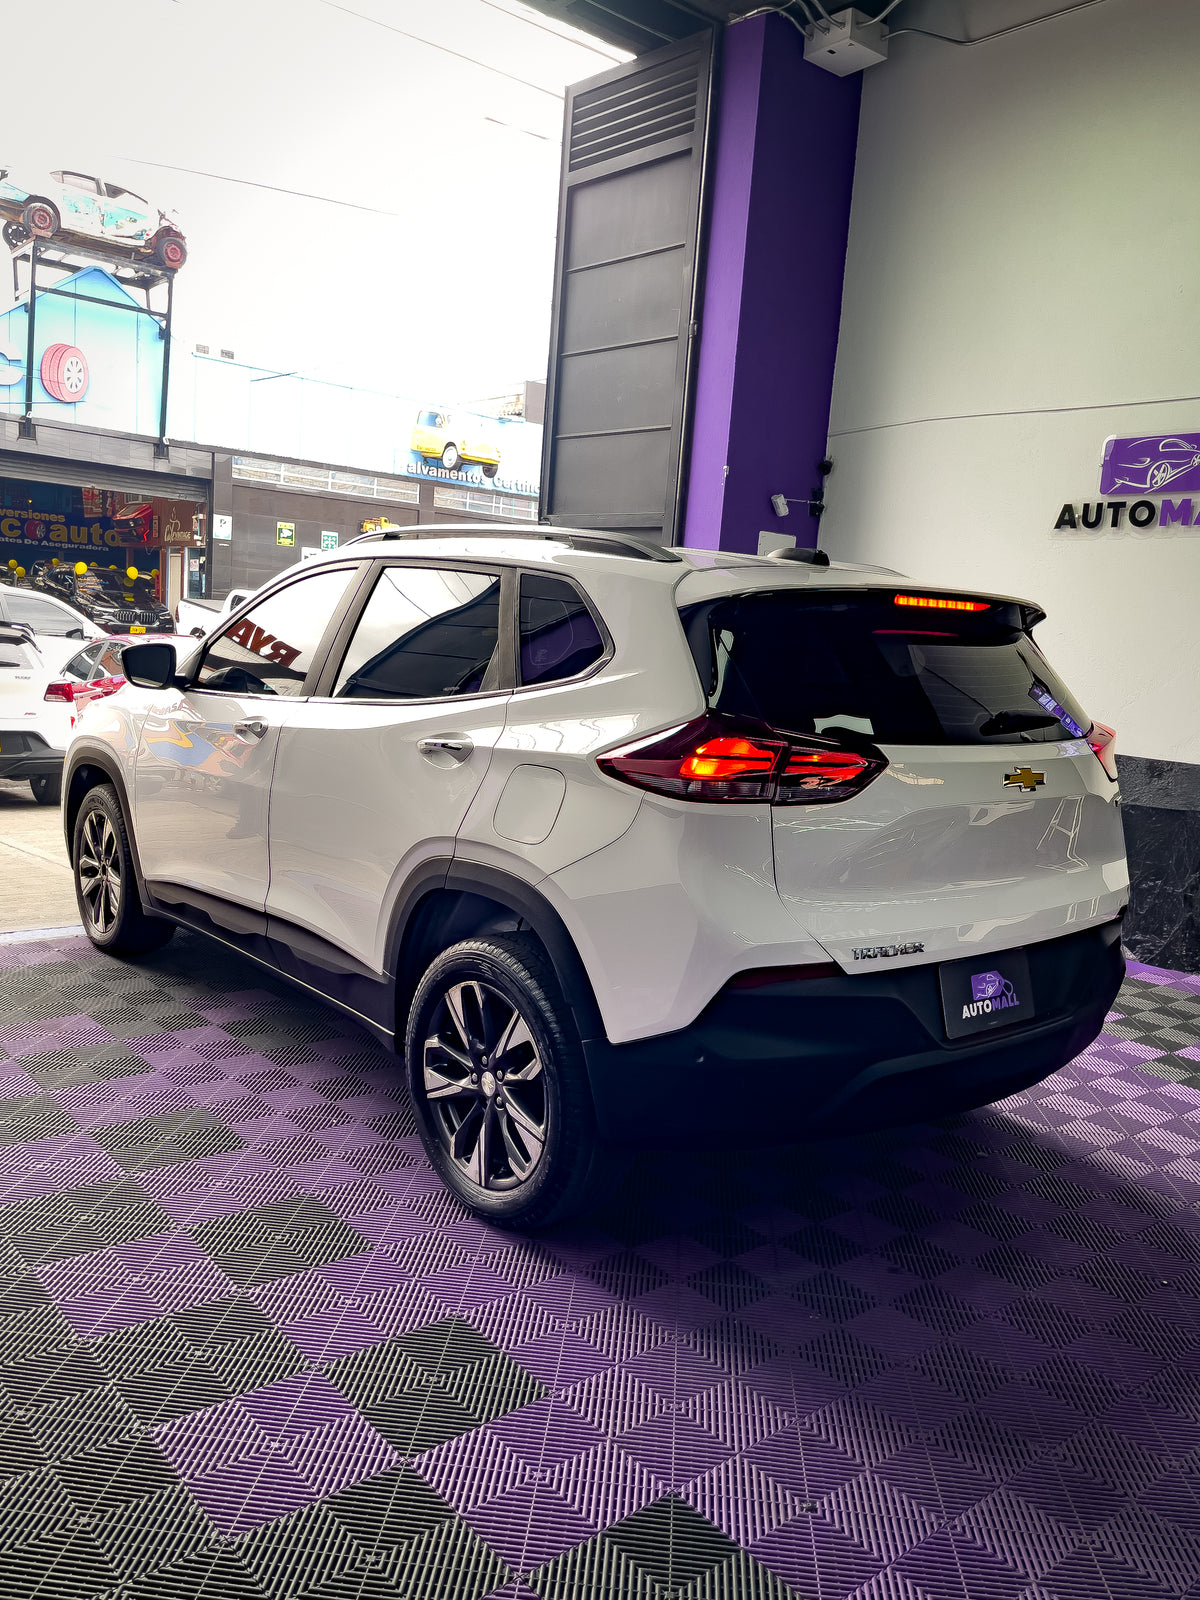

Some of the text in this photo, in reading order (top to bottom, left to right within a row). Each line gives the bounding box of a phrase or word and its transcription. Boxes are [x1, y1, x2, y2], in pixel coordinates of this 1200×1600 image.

[405, 461, 489, 485] alvamentos
[24, 538, 40, 546] De
[41, 540, 109, 552] Aseguradora
[962, 993, 1020, 1020] AUTOMALL
